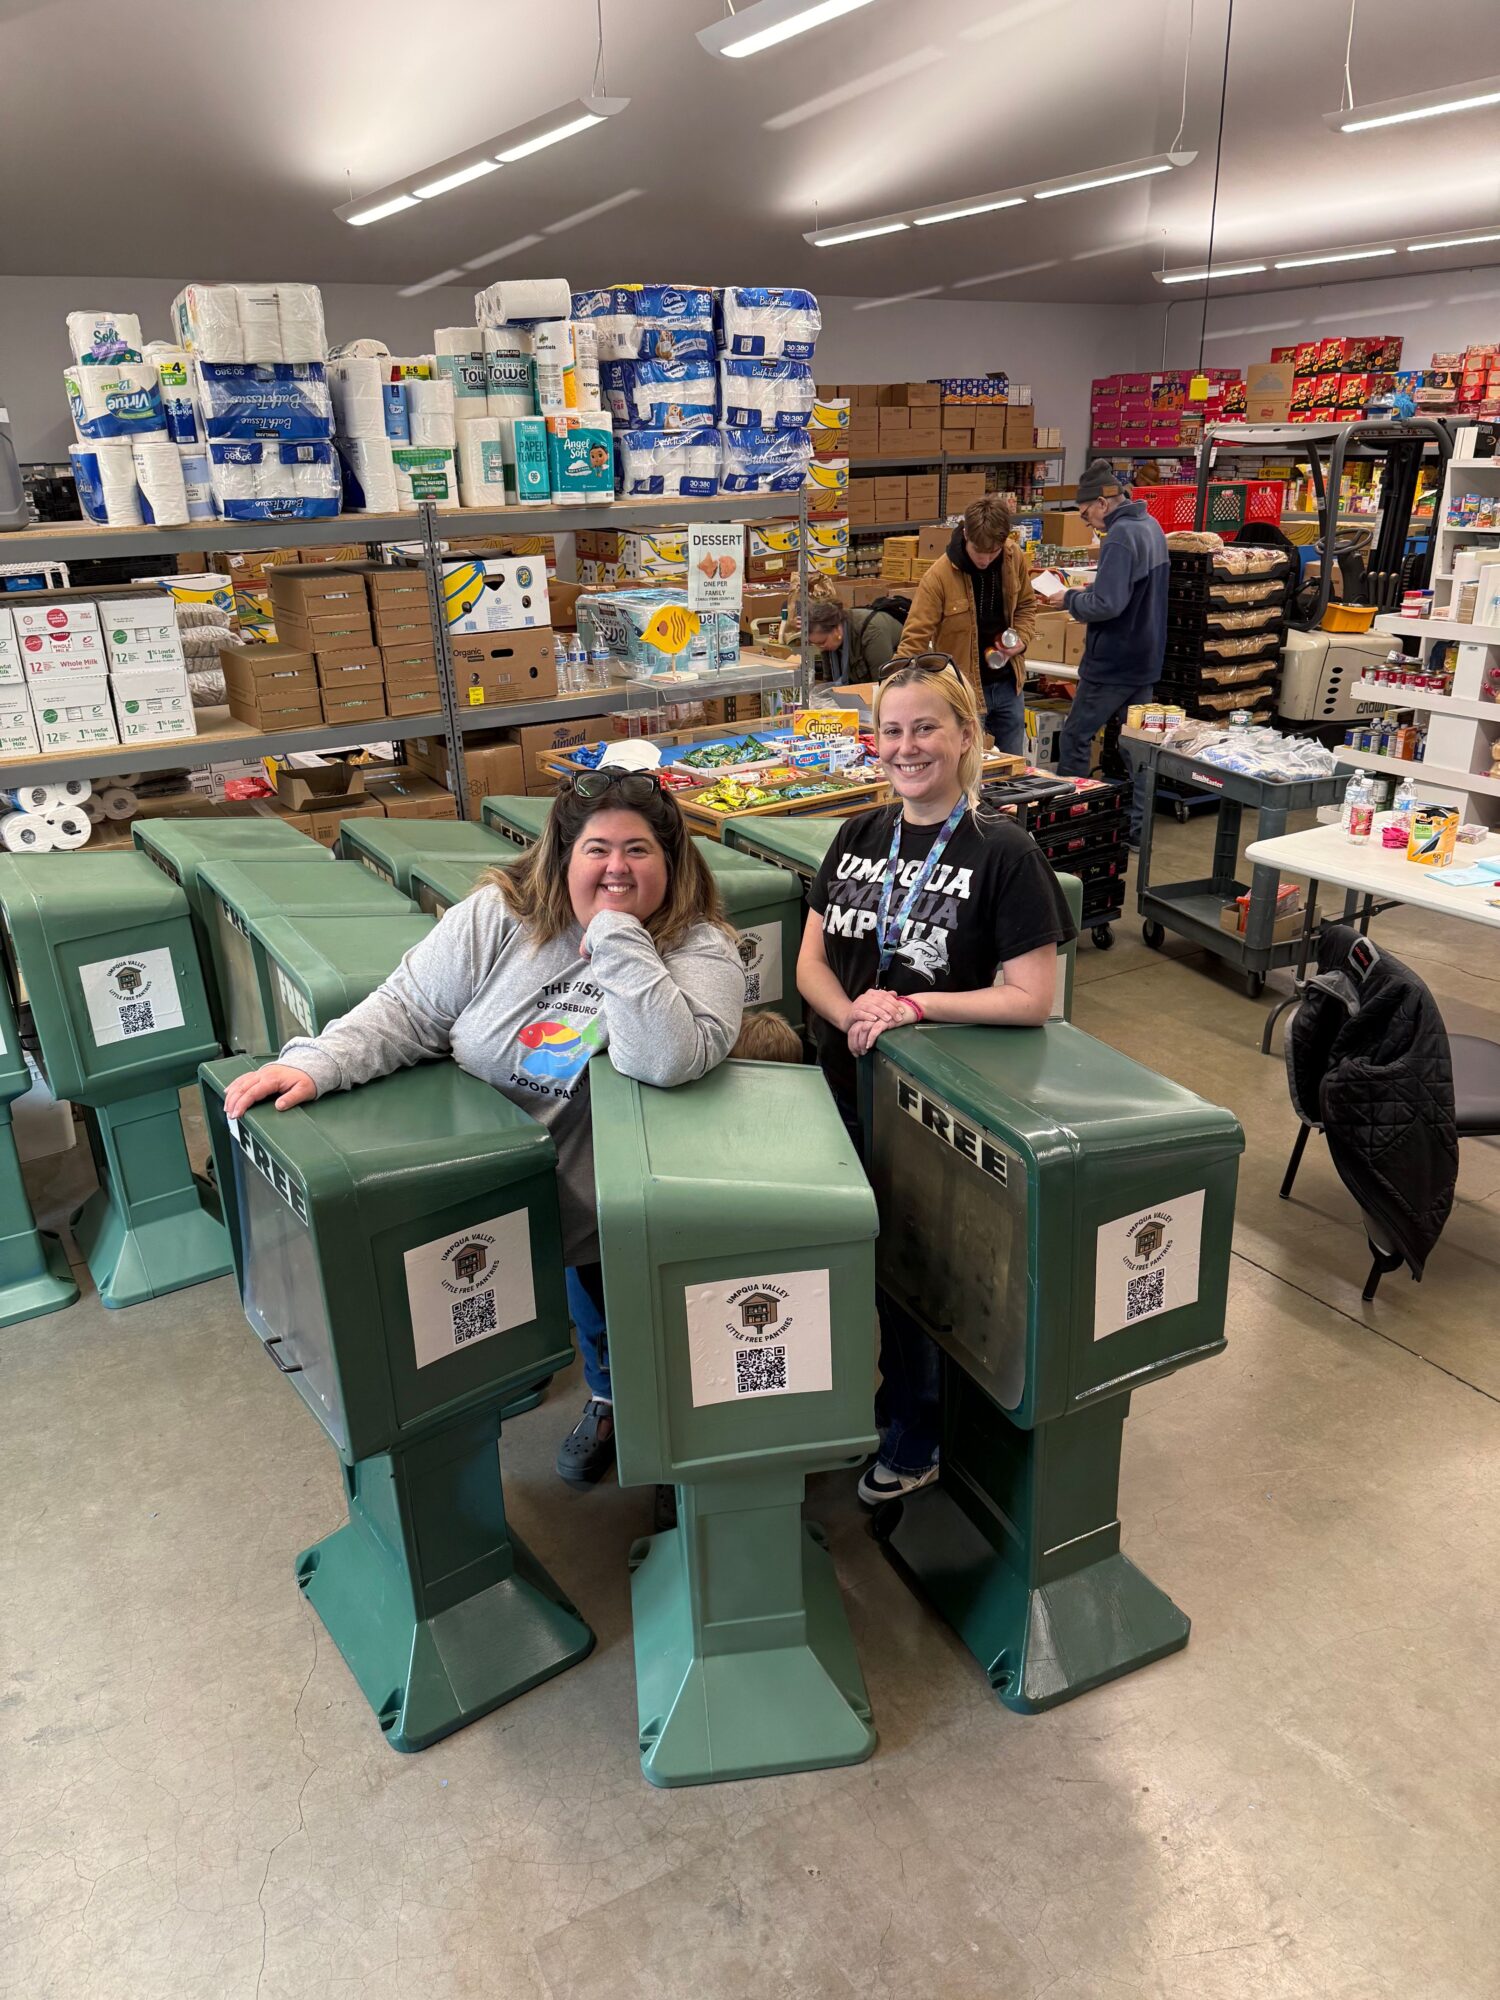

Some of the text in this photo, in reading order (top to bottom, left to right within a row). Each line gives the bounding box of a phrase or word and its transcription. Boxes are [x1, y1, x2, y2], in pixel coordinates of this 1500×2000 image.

[93, 329, 120, 345] Soft
[488, 365, 530, 382] Towel
[107, 392, 150, 410] Virtue
[167, 408, 193, 417] Sparkle
[791, 414, 804, 422] 380
[240, 417, 292, 430] Bath Tissue
[519, 441, 545, 451] PAPER
[564, 438, 590, 450] Angel
[518, 451, 546, 463] TOWELS
[570, 448, 588, 459] Soft
[693, 535, 742, 546] DESSERT
[116, 653, 128, 663] 12
[147, 649, 158, 660] 1%
[453, 648, 482, 659] Organic
[29, 658, 98, 672] 12 Whole Milk
[126, 724, 138, 734] 12
[156, 720, 167, 730] 1%
[805, 719, 843, 734] Ginger
[46, 732, 58, 743] 12
[78, 729, 90, 739] 1%
[552, 728, 586, 749] Almond
[106, 960, 147, 977] UMPQUA VALLEY
[109, 988, 122, 1001] LITTLE
[136, 980, 152, 999] PANTRIES
[541, 981, 604, 1002] THE FISH
[536, 1000, 551, 1010] OF
[510, 1073, 550, 1094] FOOD
[898, 1079, 1007, 1186] FREE
[237, 1119, 307, 1223] FREE
[1126, 1212, 1173, 1238] UMPQUA VALLEY
[441, 1233, 496, 1262] UMPQUA VALLEY
[1122, 1239, 1173, 1271] LITTLE FREE PANTRIES
[441, 1260, 500, 1294] LITTLE FREE PANTRIES
[726, 1283, 790, 1305] UMPQUA VALLEY
[725, 1323, 744, 1341] LITTLE
[765, 1316, 793, 1342] PANTRIES
